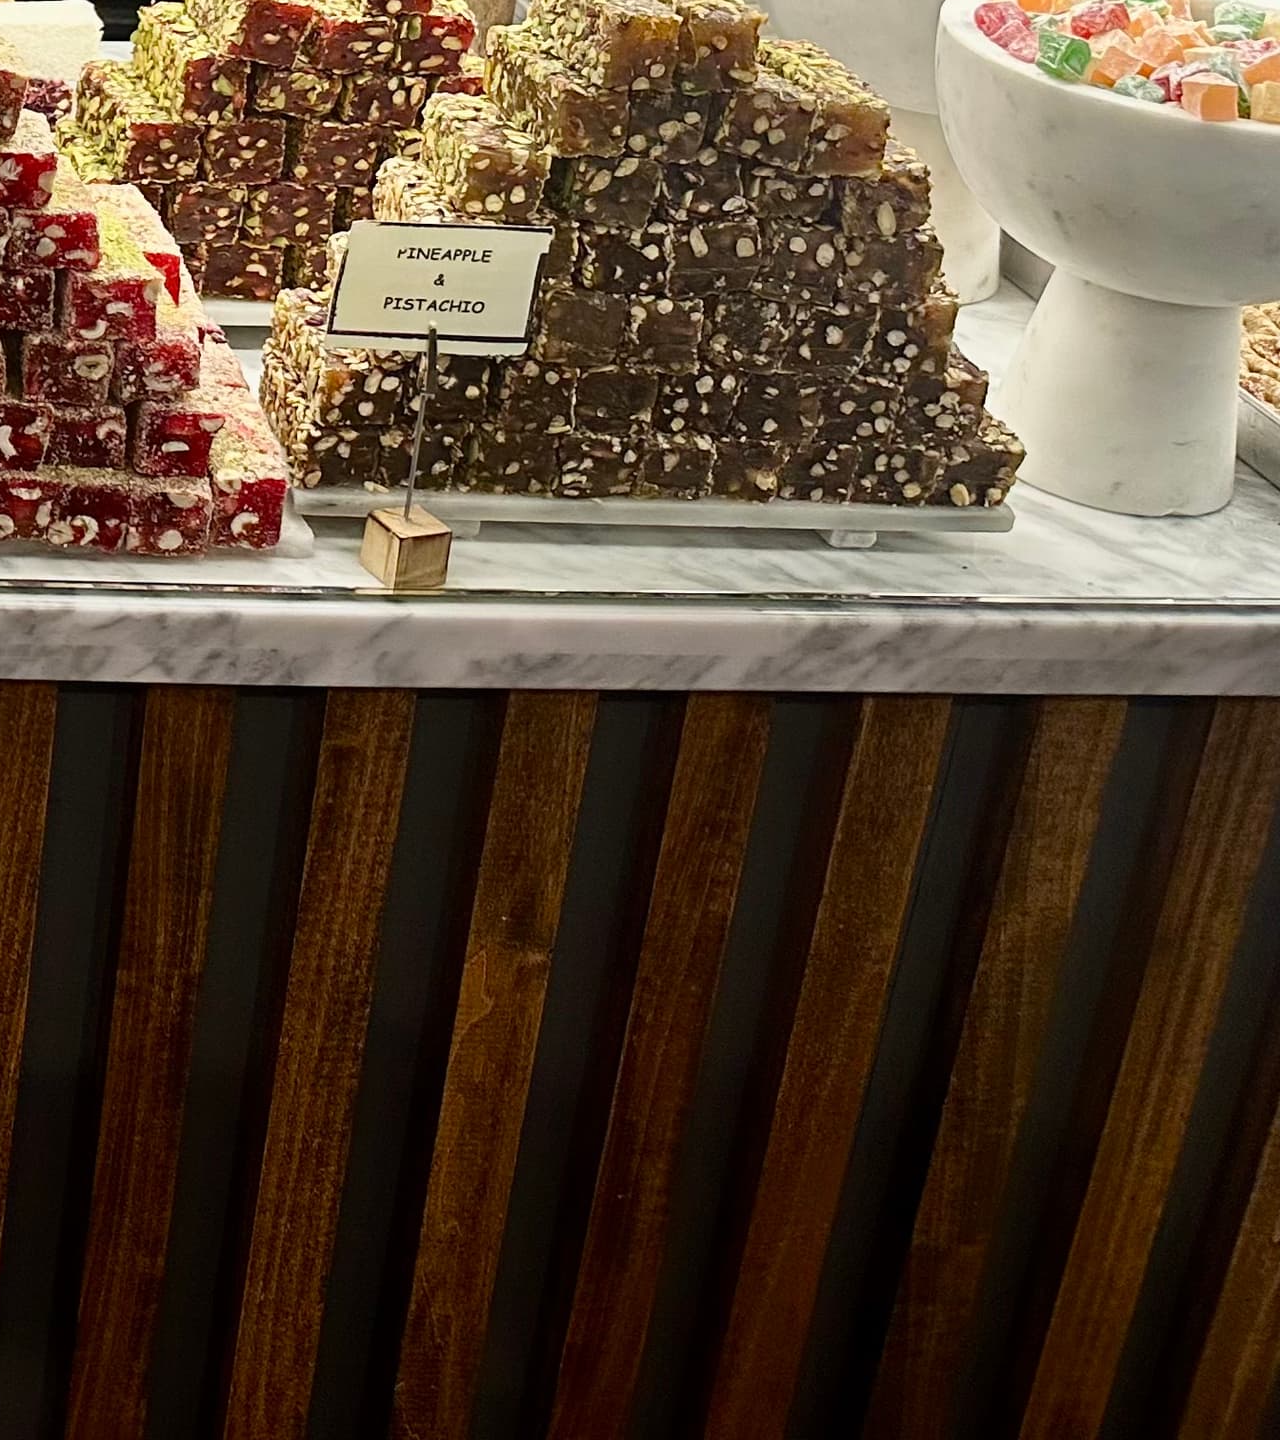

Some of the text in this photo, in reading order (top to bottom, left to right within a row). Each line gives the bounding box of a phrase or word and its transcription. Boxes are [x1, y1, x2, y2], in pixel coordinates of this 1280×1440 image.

[397, 247, 493, 263] PINEAPPLE
[433, 273, 445, 287] &
[383, 296, 485, 314] PISTACHIO
